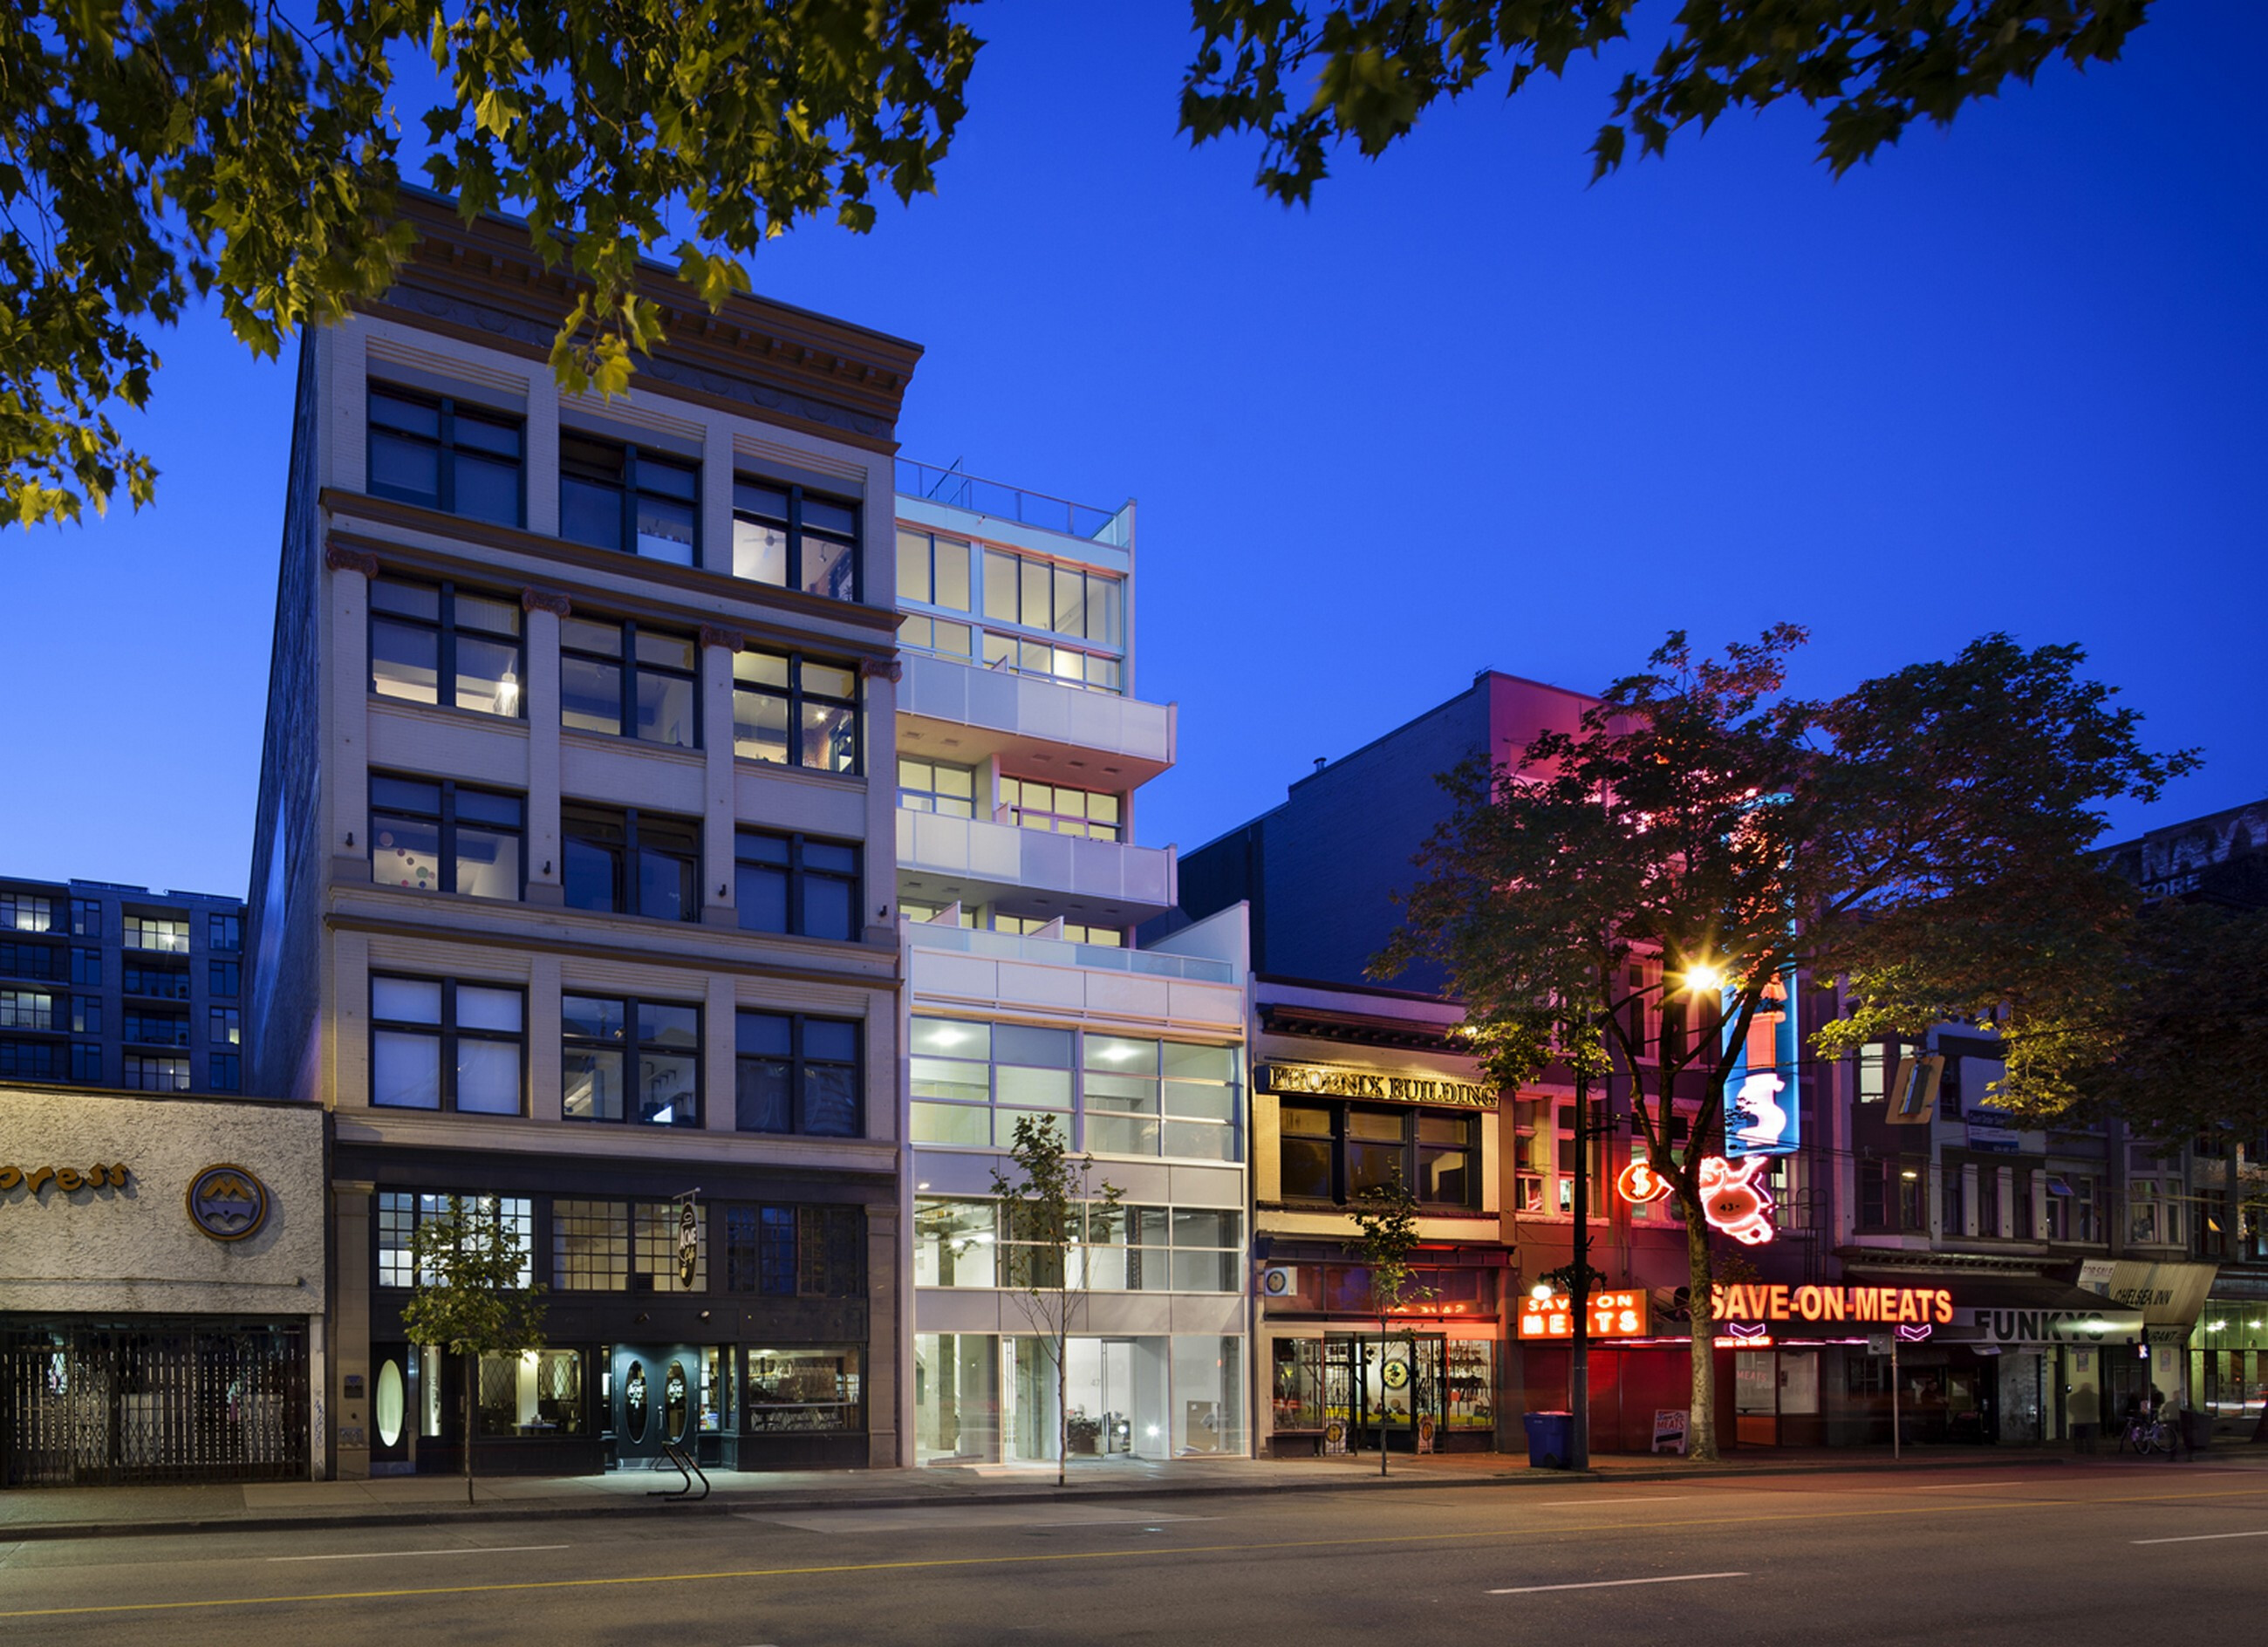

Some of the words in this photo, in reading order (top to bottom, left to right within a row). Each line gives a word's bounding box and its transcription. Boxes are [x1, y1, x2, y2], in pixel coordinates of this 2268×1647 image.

[1271, 1065, 1384, 1097] PHOENIX
[1388, 1076, 1498, 1106] BUILDING
[1528, 1295, 1633, 1312] SAV-ON
[1711, 1284, 1953, 1323] SAVE-ON-MEATS
[2114, 1288, 2153, 1305] CHELSEA
[2154, 1289, 2174, 1306] INN
[1523, 1310, 1639, 1334] METS
[1737, 1370, 1766, 1383] MEATS
[1657, 1418, 1684, 1431] MEATS
